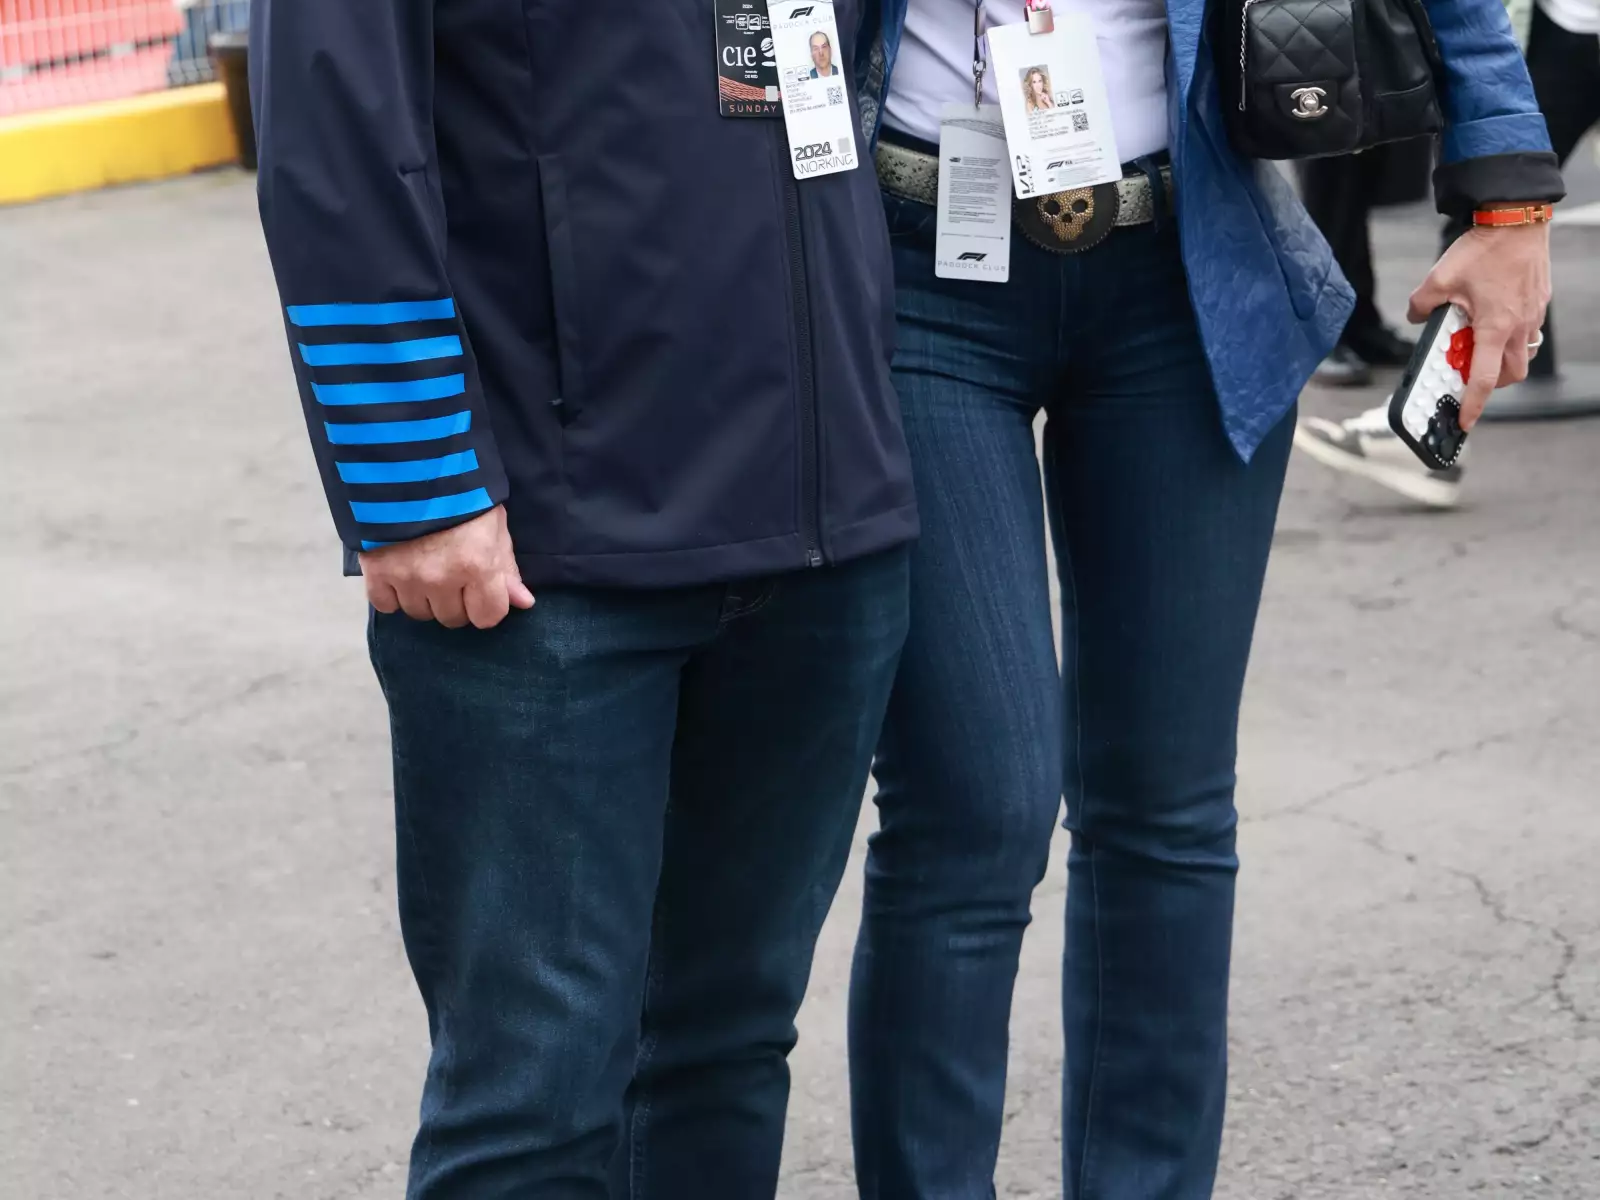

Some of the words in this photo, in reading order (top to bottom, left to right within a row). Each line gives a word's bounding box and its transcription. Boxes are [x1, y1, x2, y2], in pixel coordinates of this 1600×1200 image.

[729, 104, 776, 113] SUNDAY
[794, 141, 832, 161] 2024
[796, 153, 853, 174] WORKING
[1016, 155, 1030, 195] VIP
[937, 260, 979, 270] PADDOCK
[982, 264, 1006, 272] CLUB
